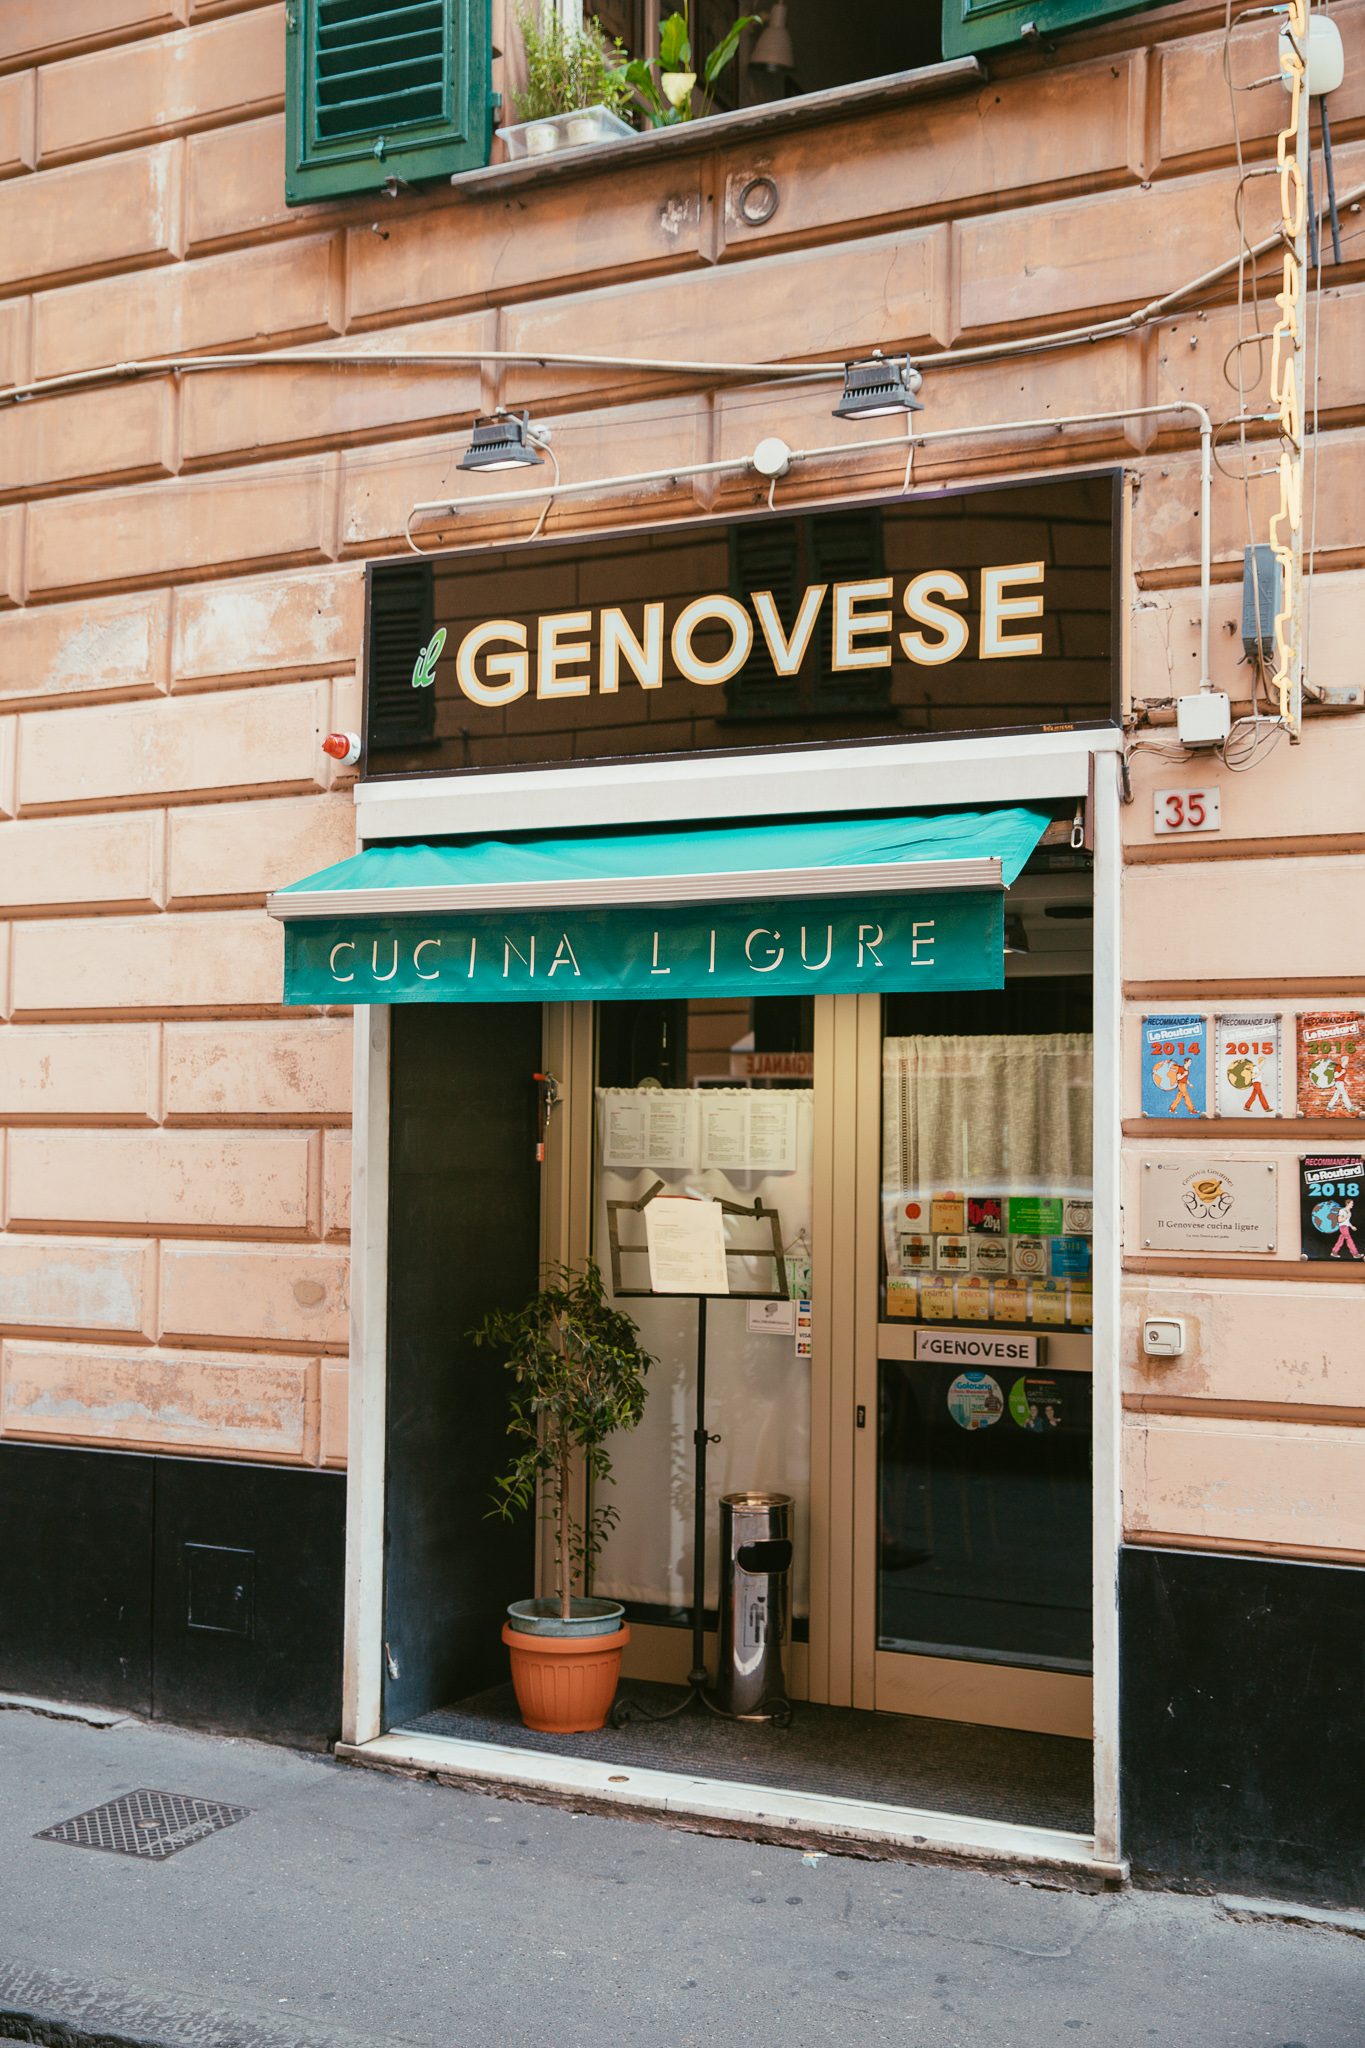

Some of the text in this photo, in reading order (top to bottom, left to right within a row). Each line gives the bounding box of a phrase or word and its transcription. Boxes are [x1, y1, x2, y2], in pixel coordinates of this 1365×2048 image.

[412, 561, 1045, 707] il GENOVESE
[1165, 793, 1206, 827] 35
[330, 920, 936, 982] CUCINA LIGURE
[1149, 1025, 1200, 1041] Le Routard
[1305, 1023, 1356, 1040] Le Routard
[1150, 1042, 1200, 1055] 2014
[1225, 1042, 1274, 1055] 2015
[1307, 1041, 1357, 1054] 2016
[1182, 1168, 1234, 1187] Genova Gourmet
[1307, 1165, 1362, 1181] Le Routard
[1308, 1182, 1360, 1197] 2018
[983, 1215, 1000, 1231] 2014
[1166, 1220, 1205, 1229] Genovese
[1206, 1222, 1232, 1230] cucina
[1234, 1222, 1259, 1232] ligure
[924, 1289, 950, 1299] osterie
[930, 1339, 1029, 1359] GENOVESE
